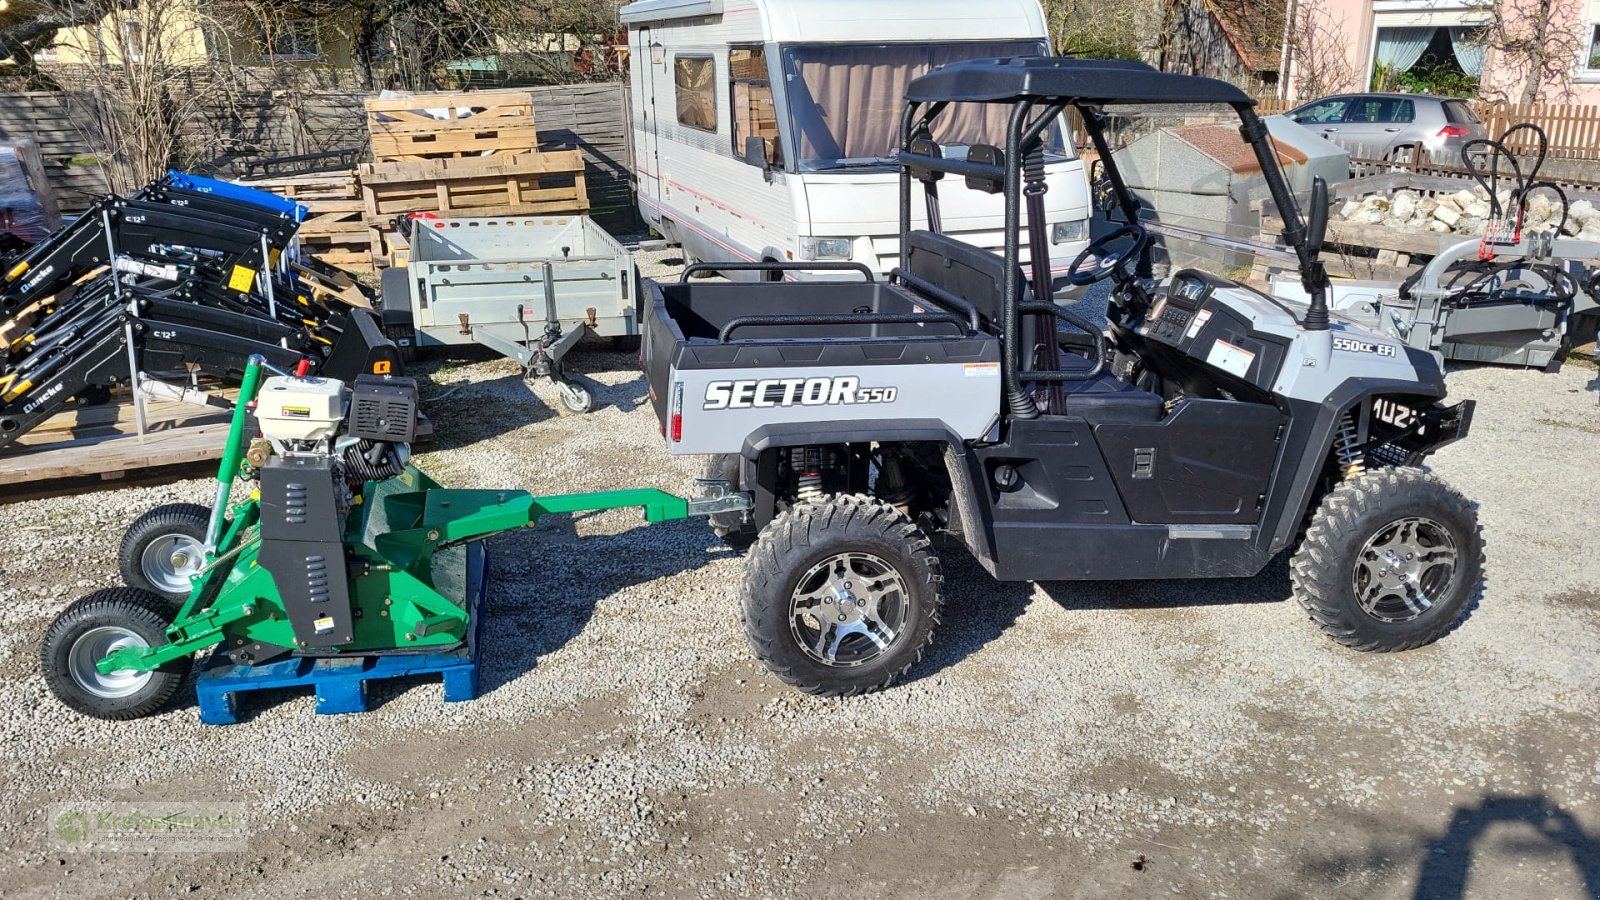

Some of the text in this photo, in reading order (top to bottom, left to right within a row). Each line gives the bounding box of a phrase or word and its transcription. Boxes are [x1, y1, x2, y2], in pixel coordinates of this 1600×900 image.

[20, 265, 54, 293] Quicke
[1377, 343, 1397, 358] EFI
[23, 382, 63, 413] Quicke
[703, 375, 898, 410] SECTOR 550
